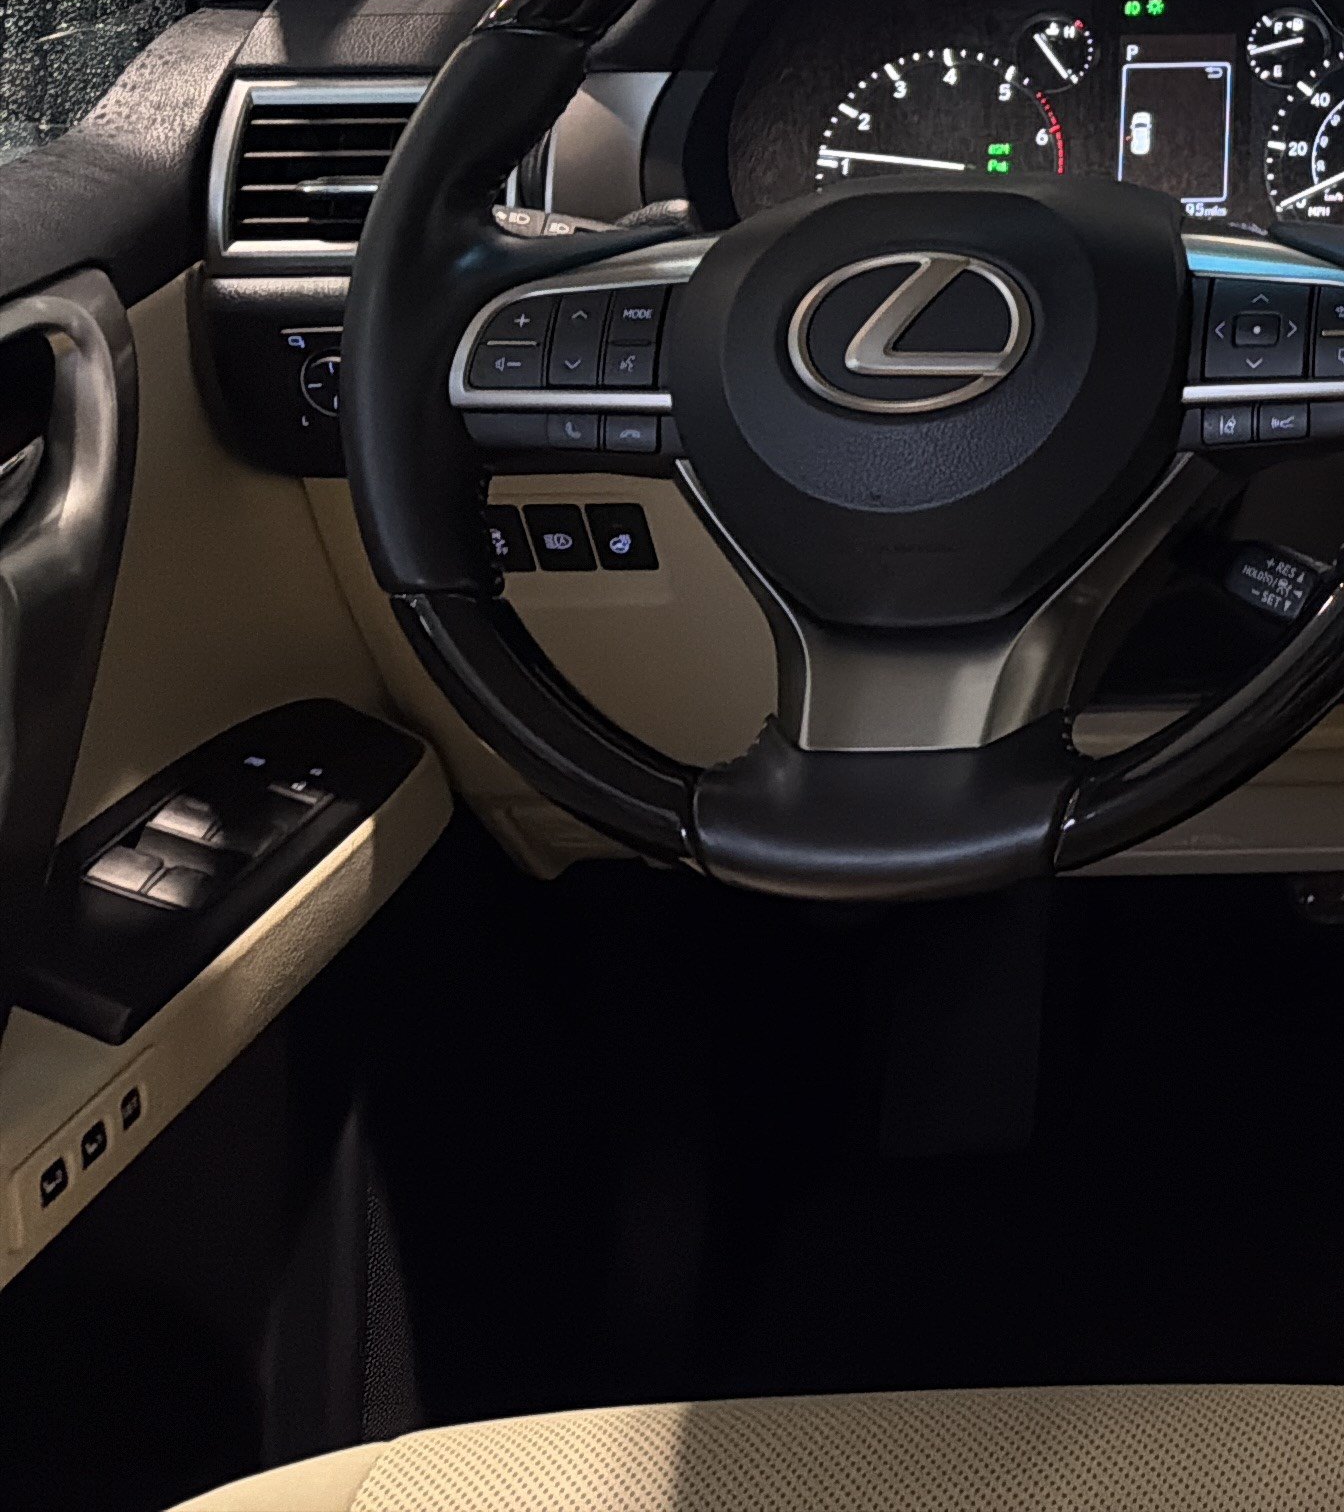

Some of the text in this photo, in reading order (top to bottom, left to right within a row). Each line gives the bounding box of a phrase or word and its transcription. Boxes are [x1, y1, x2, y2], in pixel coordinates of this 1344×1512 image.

[1125, 44, 1139, 61] P
[943, 67, 957, 85] 4
[893, 80, 907, 99] 3
[998, 83, 1011, 101] 5
[1309, 92, 1331, 108] 40
[858, 112, 872, 131] 2
[1035, 128, 1049, 146] 6
[1288, 141, 1308, 156] 20
[841, 158, 850, 176] 1
[622, 308, 652, 319] MODE
[1276, 561, 1297, 579] RES
[1261, 590, 1283, 608] SET
